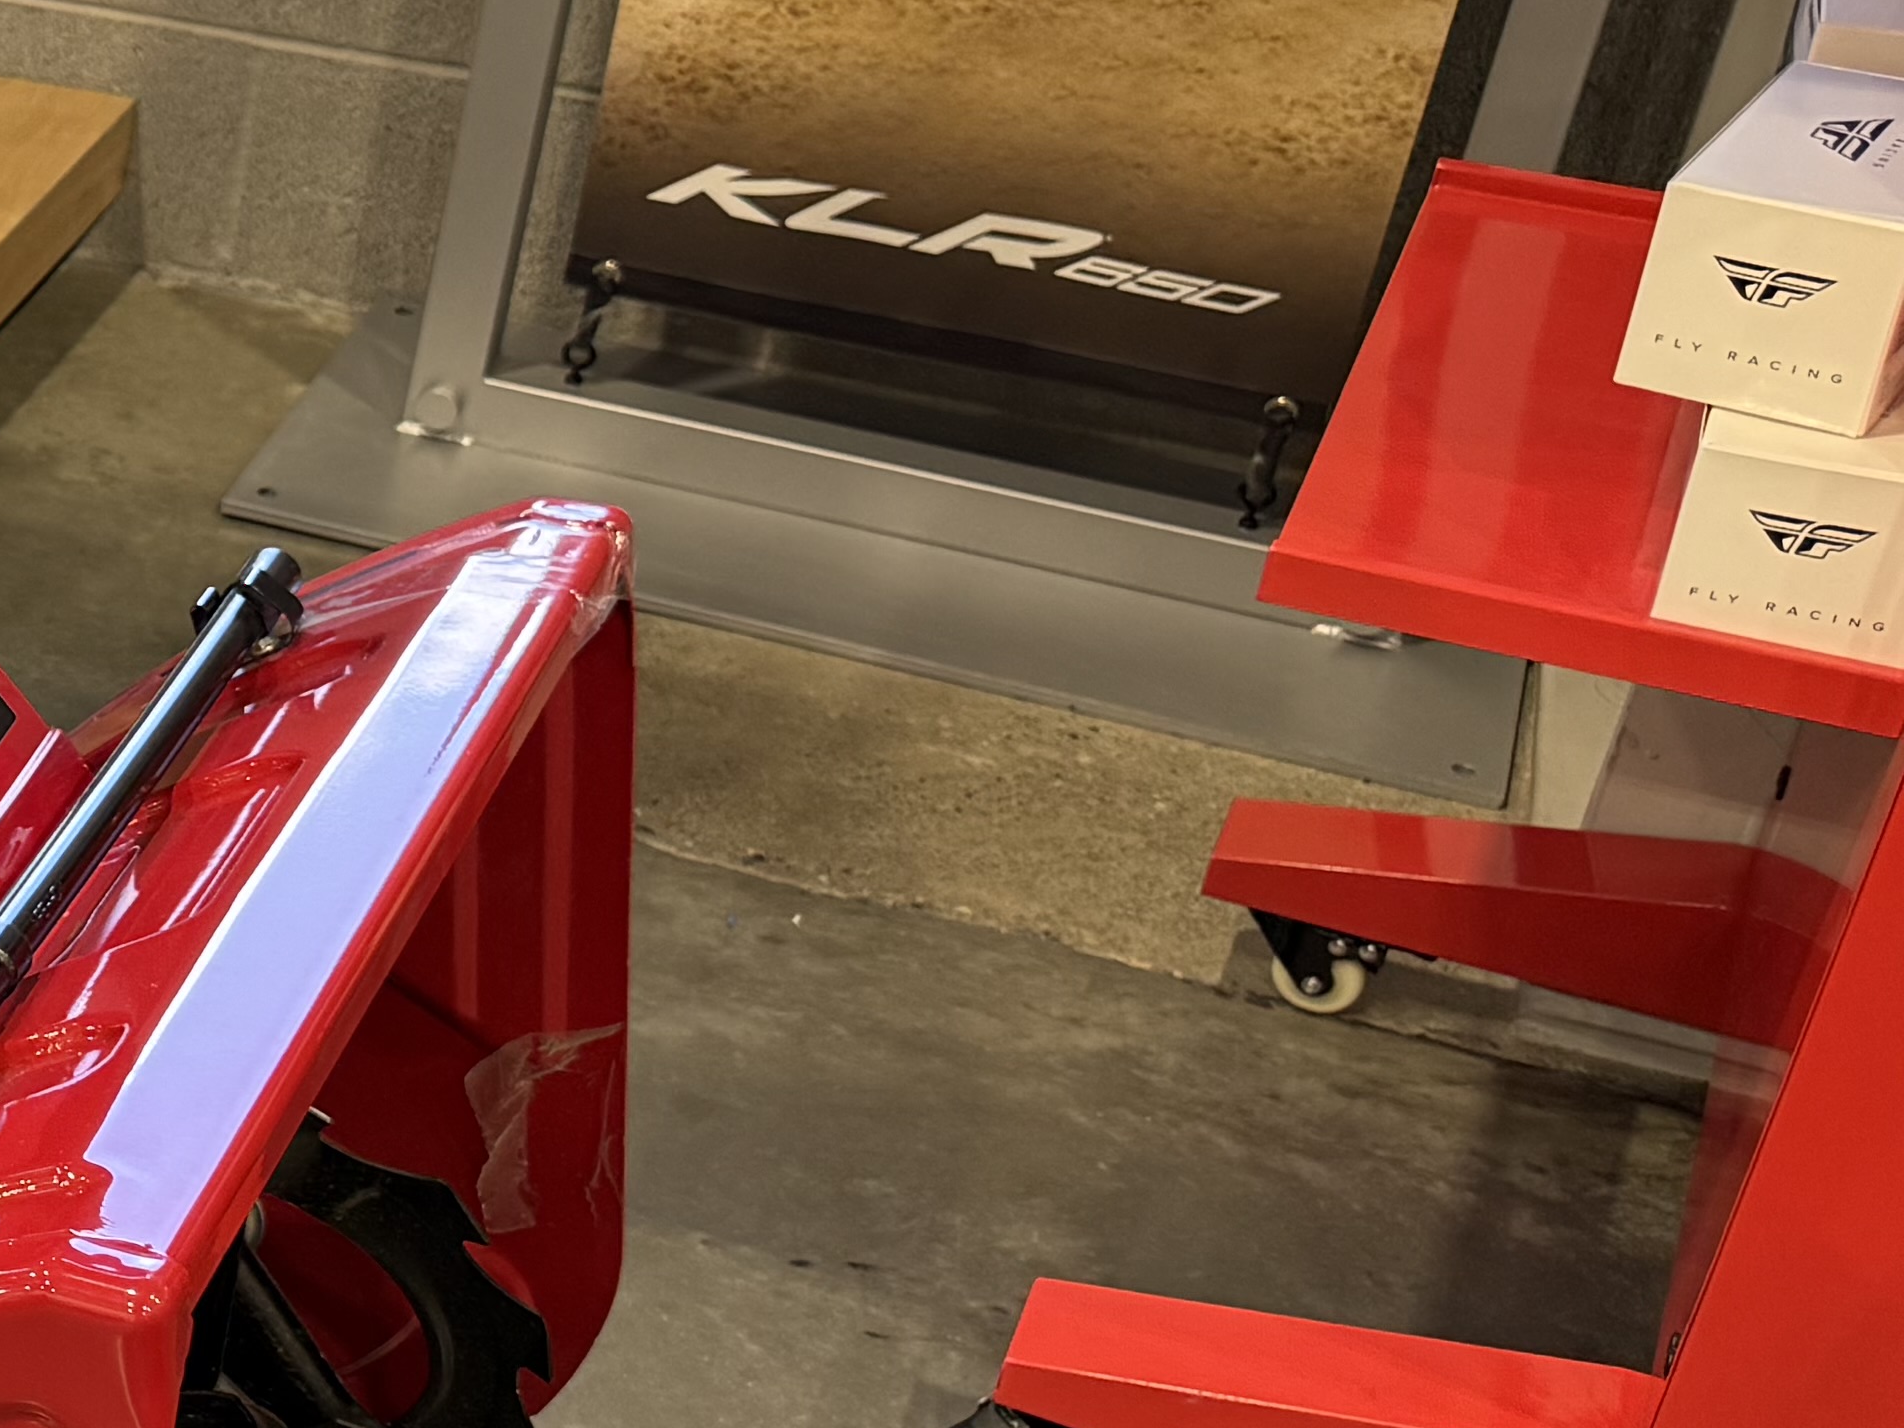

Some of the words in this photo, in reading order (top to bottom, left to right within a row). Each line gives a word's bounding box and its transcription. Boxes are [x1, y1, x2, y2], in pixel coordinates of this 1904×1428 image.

[1654, 333, 1702, 352] FLY
[1727, 350, 1843, 384] RACING
[1689, 586, 1739, 603] FLY
[1765, 601, 1885, 632] RACING
